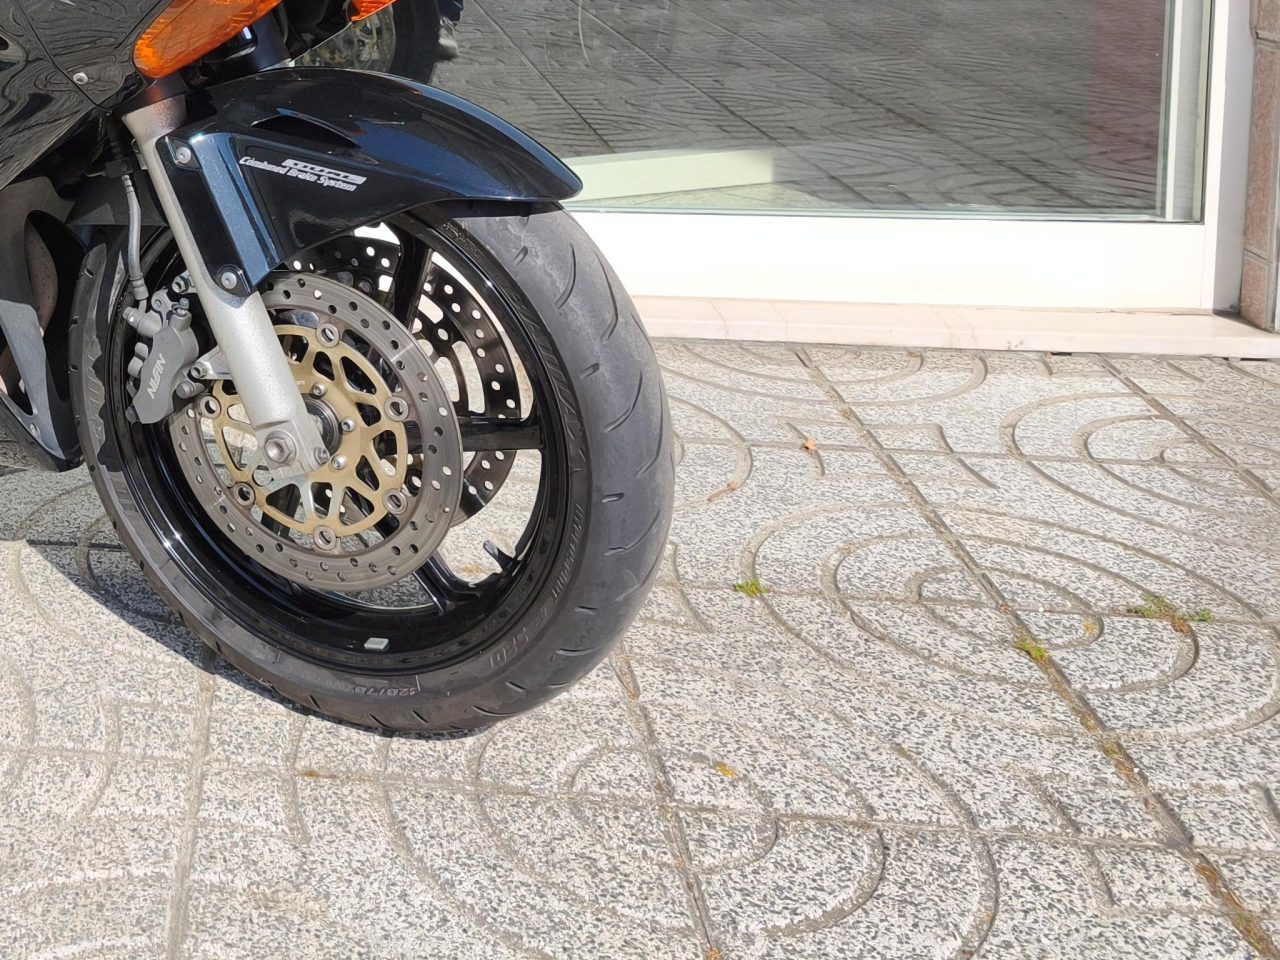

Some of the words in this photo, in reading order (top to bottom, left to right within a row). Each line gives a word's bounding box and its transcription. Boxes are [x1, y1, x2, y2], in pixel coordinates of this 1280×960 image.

[238, 156, 289, 175] Combined
[286, 167, 319, 182] Brake
[316, 175, 358, 192] System
